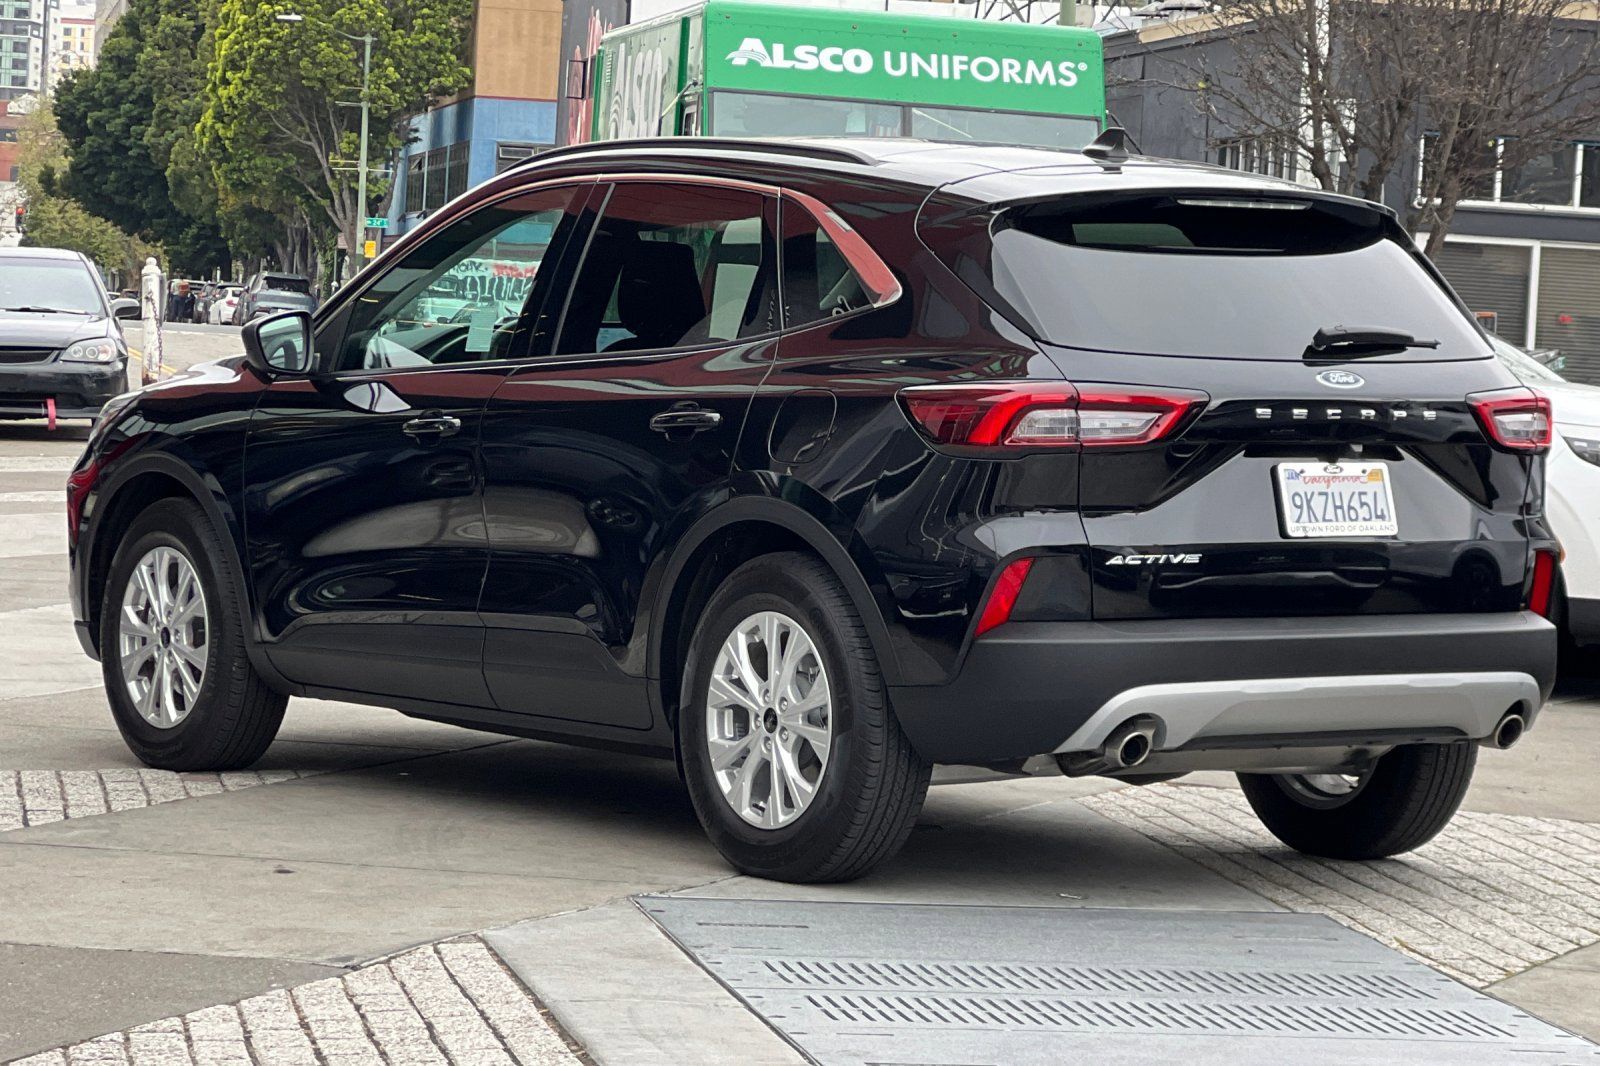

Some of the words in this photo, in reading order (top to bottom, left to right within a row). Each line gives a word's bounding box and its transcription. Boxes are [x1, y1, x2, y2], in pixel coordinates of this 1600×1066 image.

[725, 37, 873, 74] ALSCO
[1329, 372, 1355, 384] Ford
[1255, 408, 1437, 421] ESCAPE
[1292, 491, 1386, 523] 9KZH654
[1325, 525, 1345, 533] FORD
[1360, 524, 1395, 532] OAKLAND
[1105, 553, 1203, 565] ACTIVE
